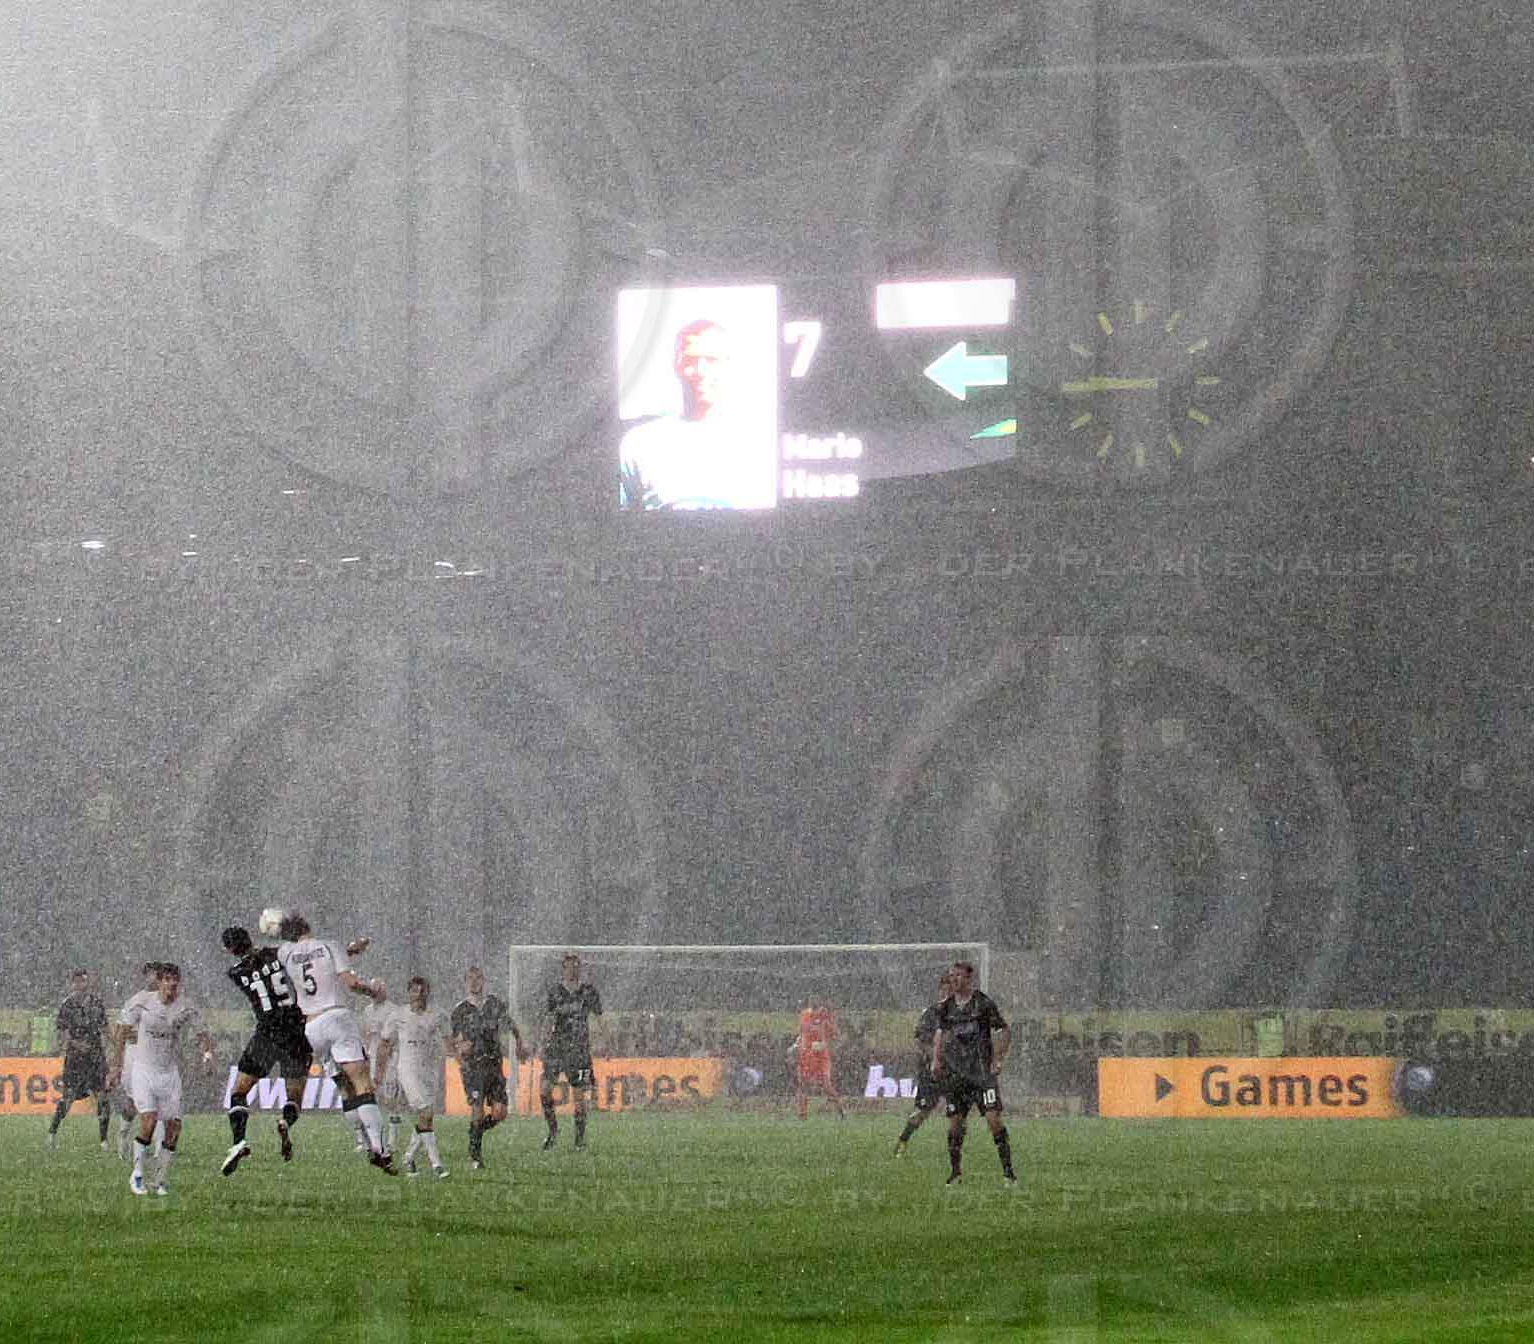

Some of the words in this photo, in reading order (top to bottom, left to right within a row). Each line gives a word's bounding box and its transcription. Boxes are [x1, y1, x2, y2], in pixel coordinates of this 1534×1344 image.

[784, 320, 823, 378] 7
[302, 962, 317, 996] 5
[1200, 1064, 1369, 1107] Games
